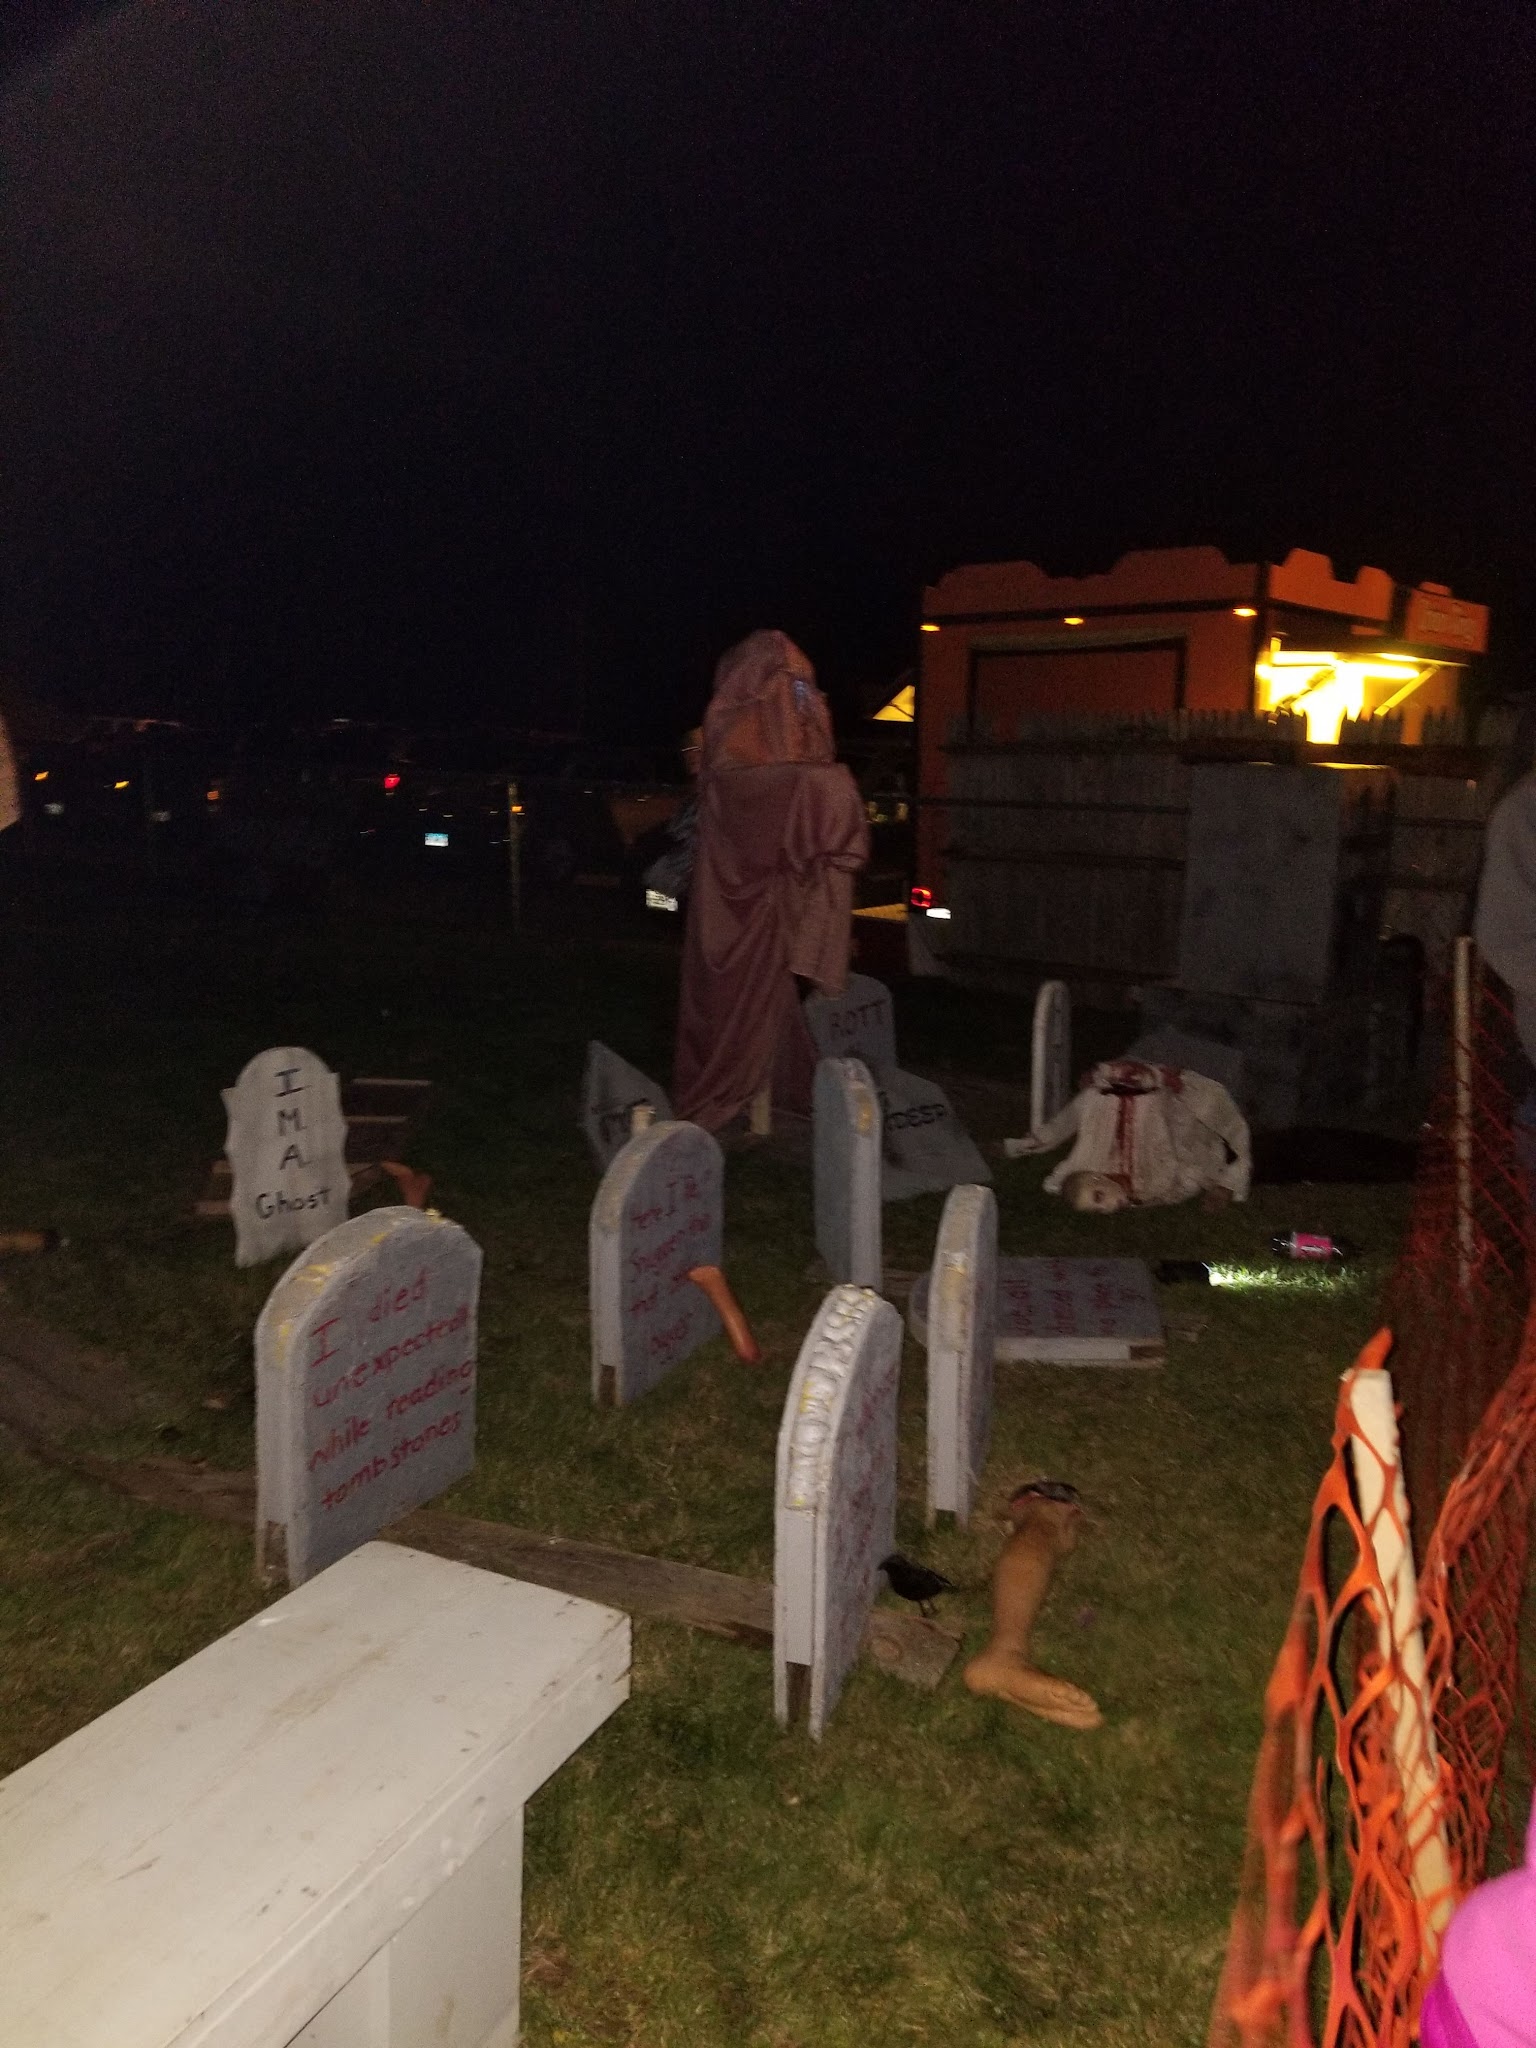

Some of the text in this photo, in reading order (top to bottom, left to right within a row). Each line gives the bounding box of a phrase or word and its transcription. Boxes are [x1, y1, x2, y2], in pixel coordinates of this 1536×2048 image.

[256, 1187, 332, 1219] Ghost
[309, 1266, 429, 1368] I died
[308, 1359, 474, 1471] while reading
